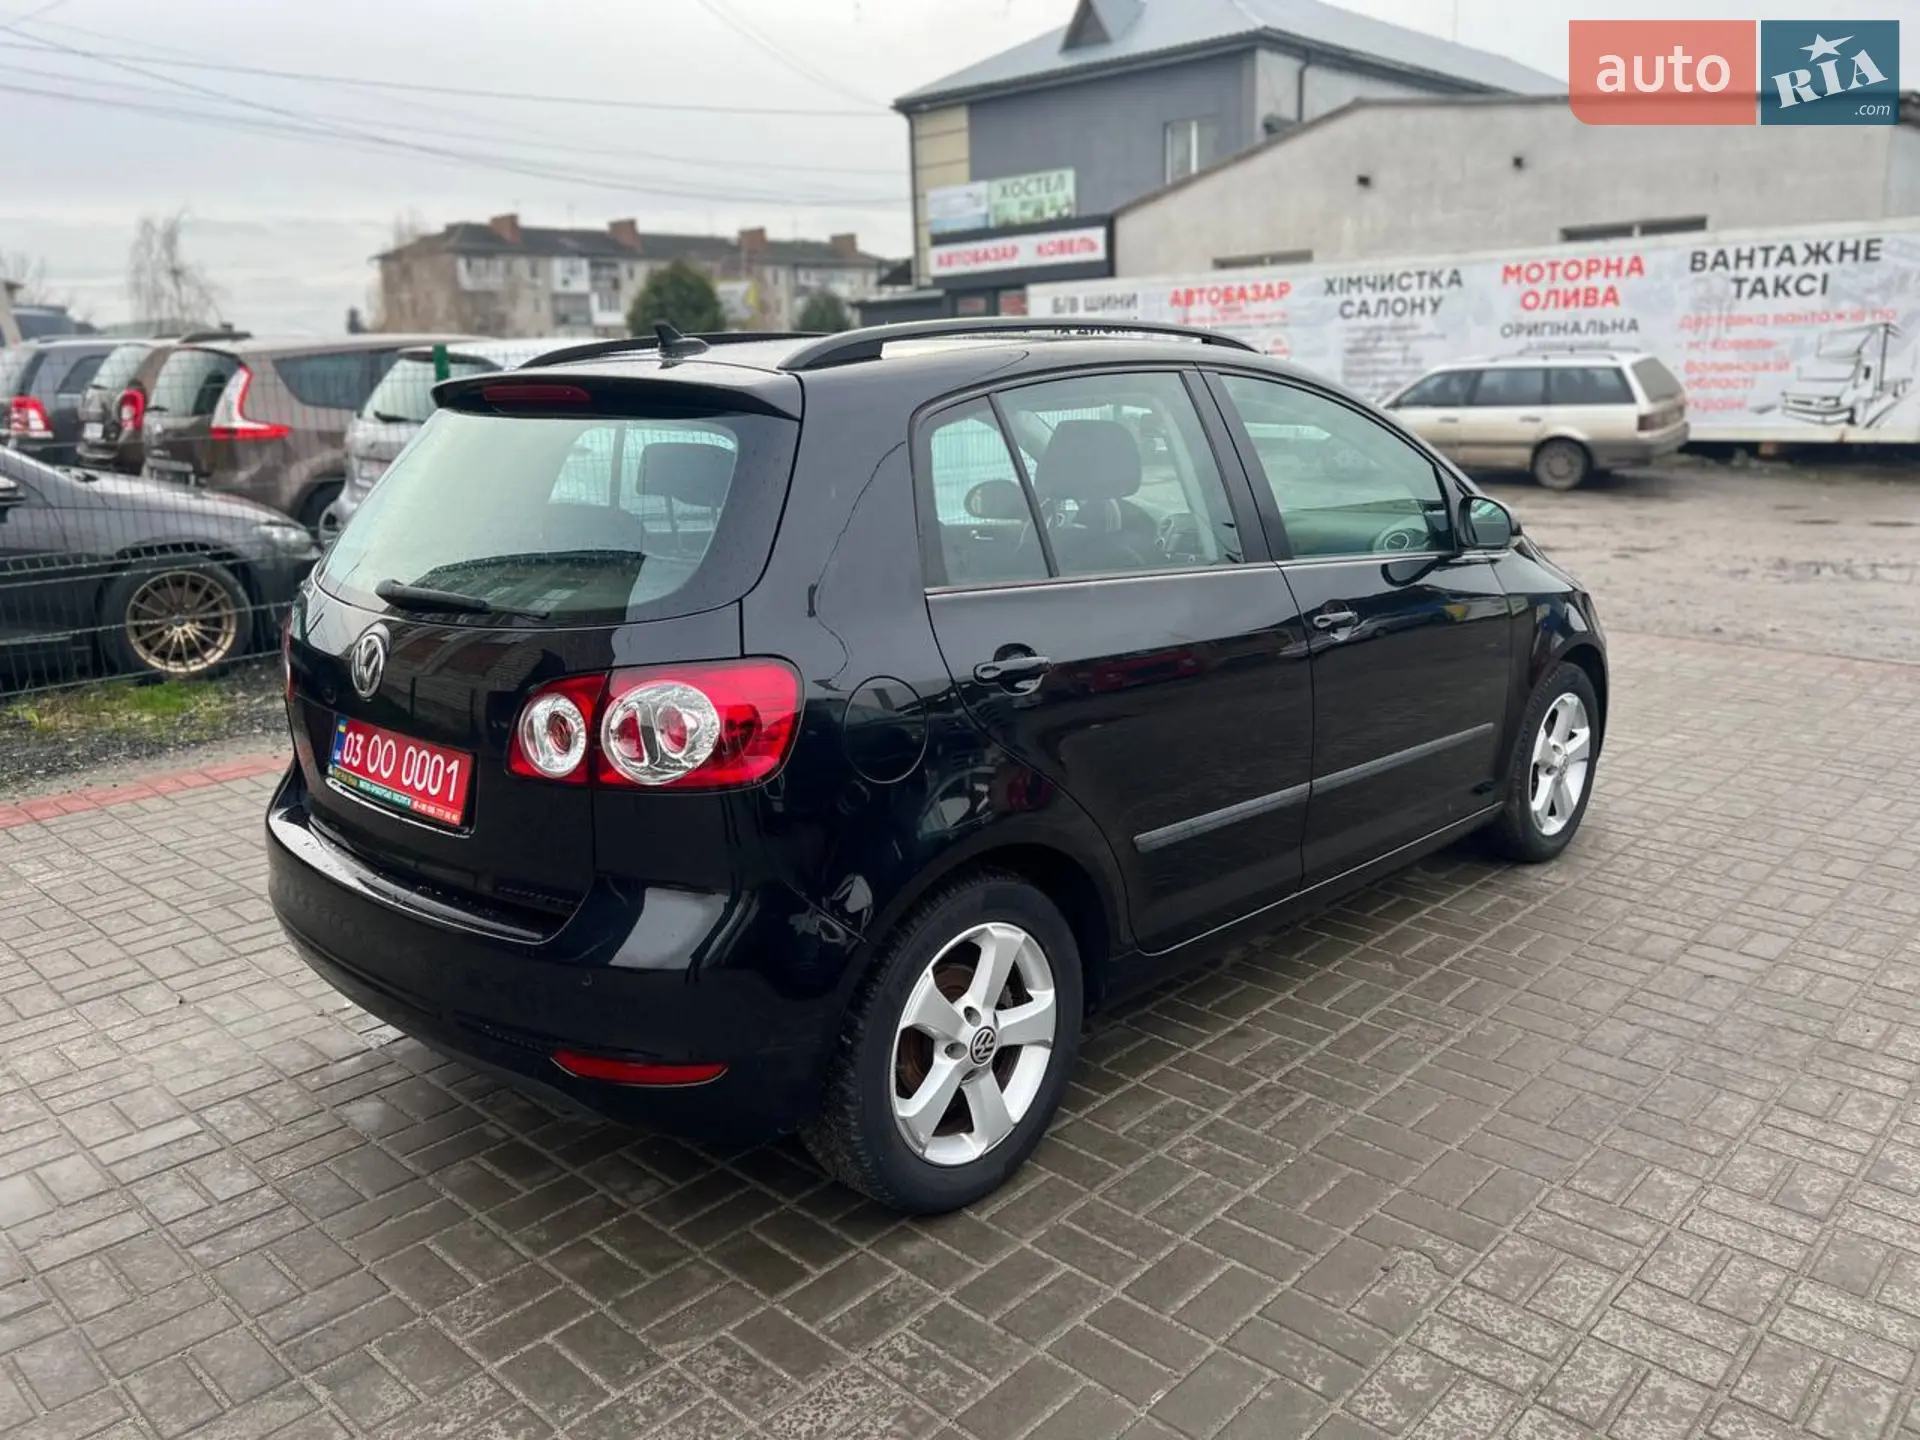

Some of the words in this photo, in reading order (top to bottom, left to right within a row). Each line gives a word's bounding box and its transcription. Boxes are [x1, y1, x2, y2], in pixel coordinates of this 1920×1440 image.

[1000, 174, 1066, 198] ХОСТЕЛ
[936, 244, 1020, 267] АВТОБАЗАР
[1036, 236, 1099, 258] КОВЕЛЬ
[1688, 237, 1884, 273] ВАНТАЖНЕ
[1323, 268, 1465, 298] ХІМЧИСТКА
[1501, 254, 1646, 285] МОТОРНА
[1169, 281, 1292, 308] АВТОБАЗАР
[1519, 285, 1621, 312] ОЛИВА
[1731, 272, 1830, 299] ТАКСІ
[1084, 293, 1138, 312] ШИНИ
[1338, 297, 1445, 320] САЛОНУ
[1500, 317, 1640, 340] ОРИГІНАЛЬНА
[342, 731, 364, 767] 03
[401, 745, 460, 802] 0001
